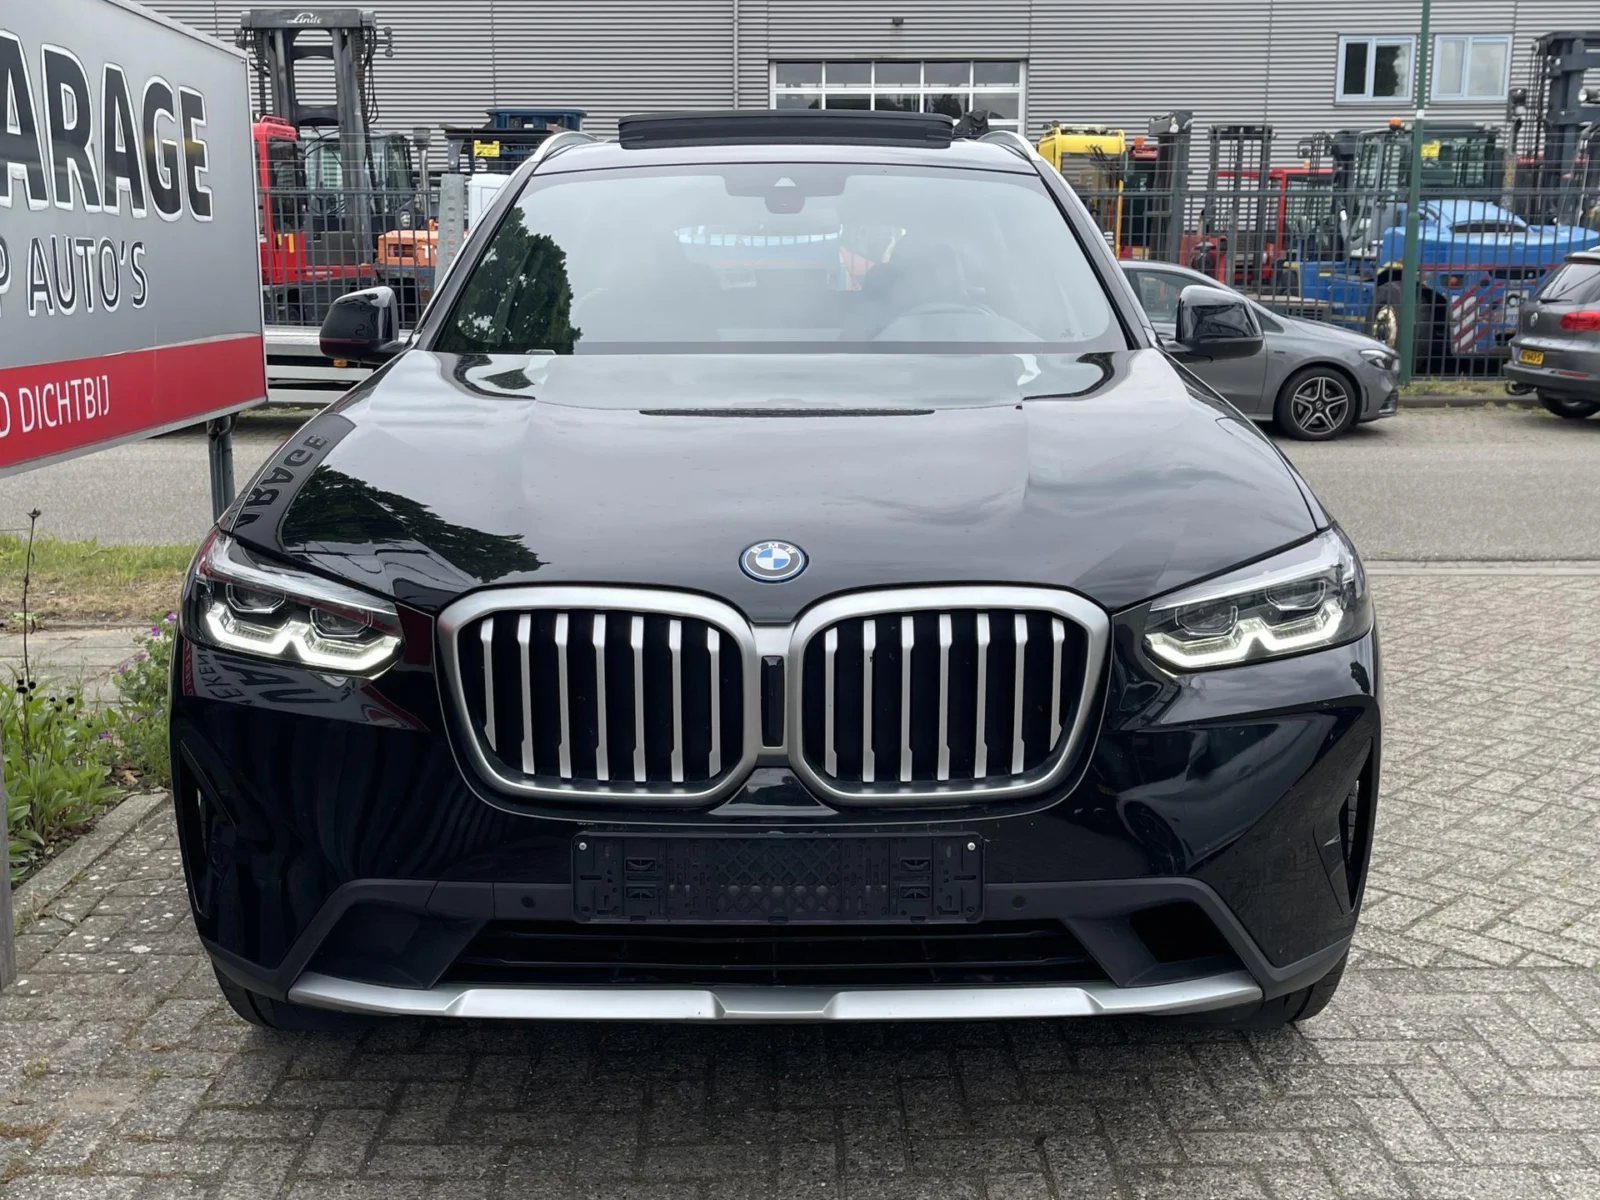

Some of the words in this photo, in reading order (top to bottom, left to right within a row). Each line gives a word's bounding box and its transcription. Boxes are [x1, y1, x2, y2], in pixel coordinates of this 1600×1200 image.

[286, 12, 322, 24] Linde
[27, 234, 149, 317] AUTO'S
[18, 374, 110, 433] DICHTBIJ
